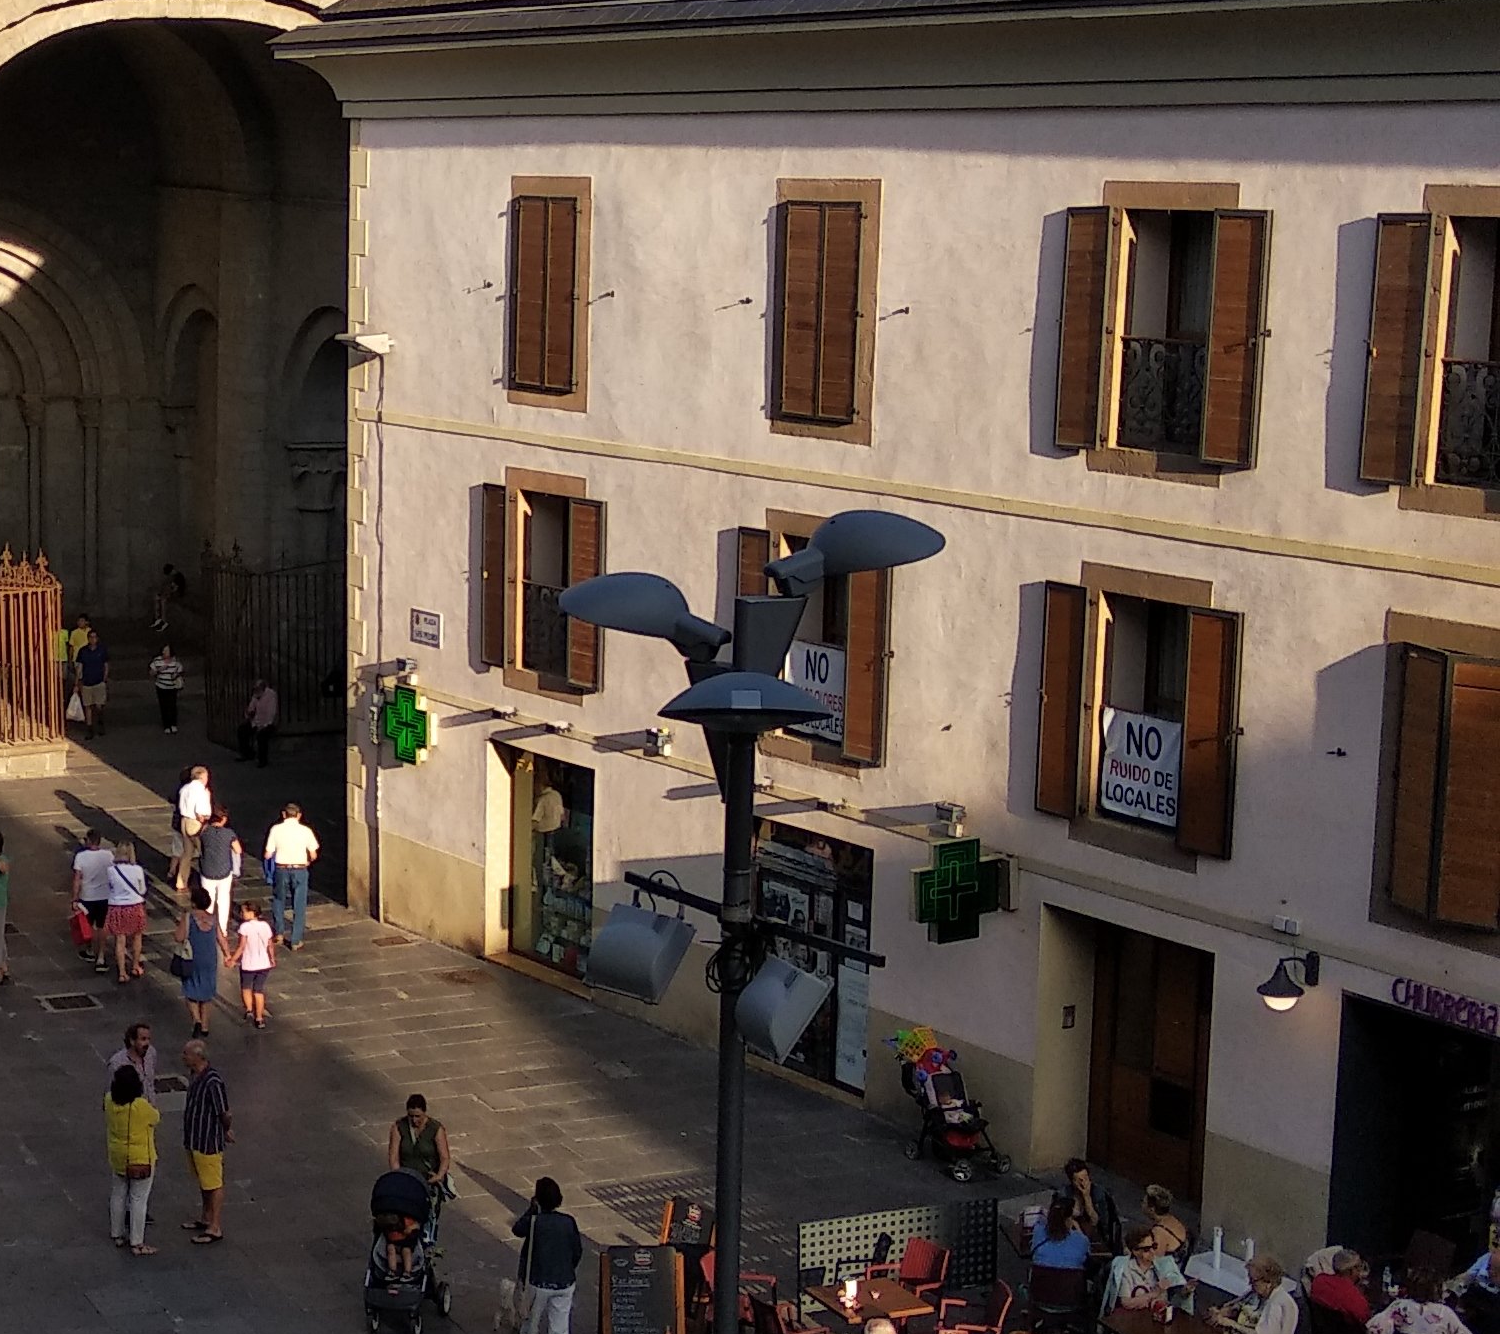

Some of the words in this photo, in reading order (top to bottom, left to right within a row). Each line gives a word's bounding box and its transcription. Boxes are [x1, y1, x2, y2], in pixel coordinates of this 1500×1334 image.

[805, 649, 829, 684] NO
[1126, 721, 1163, 761] NO
[1109, 759, 1151, 785] RUIDO
[1154, 770, 1173, 791] DE
[1105, 781, 1176, 817] LOCALES
